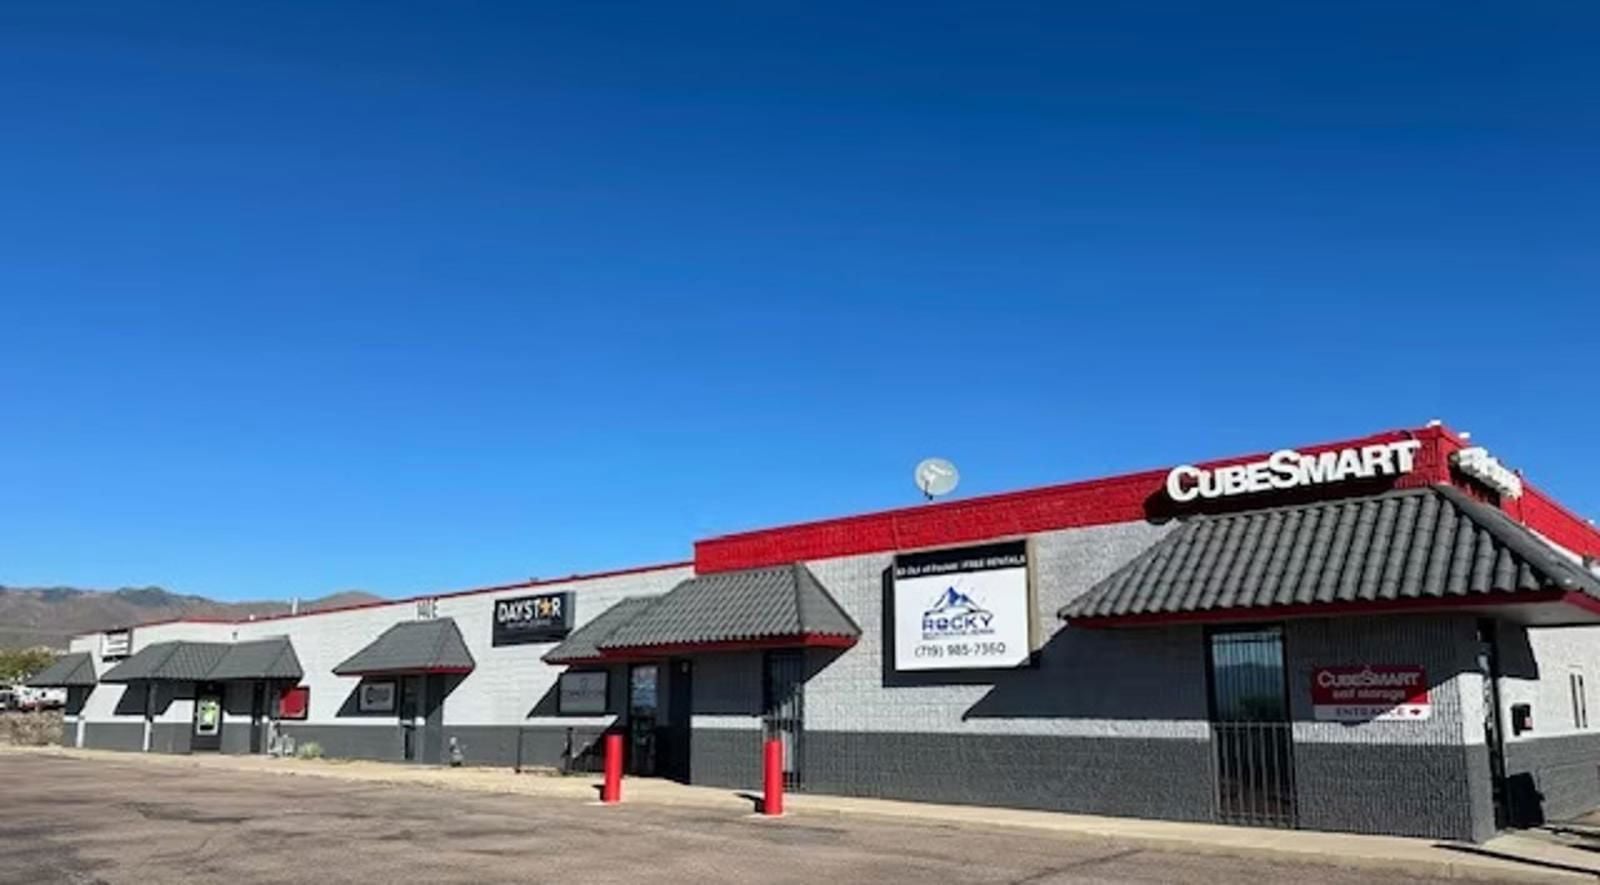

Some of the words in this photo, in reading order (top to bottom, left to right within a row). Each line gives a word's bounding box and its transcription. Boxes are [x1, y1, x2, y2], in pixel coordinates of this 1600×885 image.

[922, 613, 993, 631] ROCKY
[914, 644, 943, 658] (719)
[1332, 689, 1356, 700] self
[1357, 689, 1406, 701] storage
